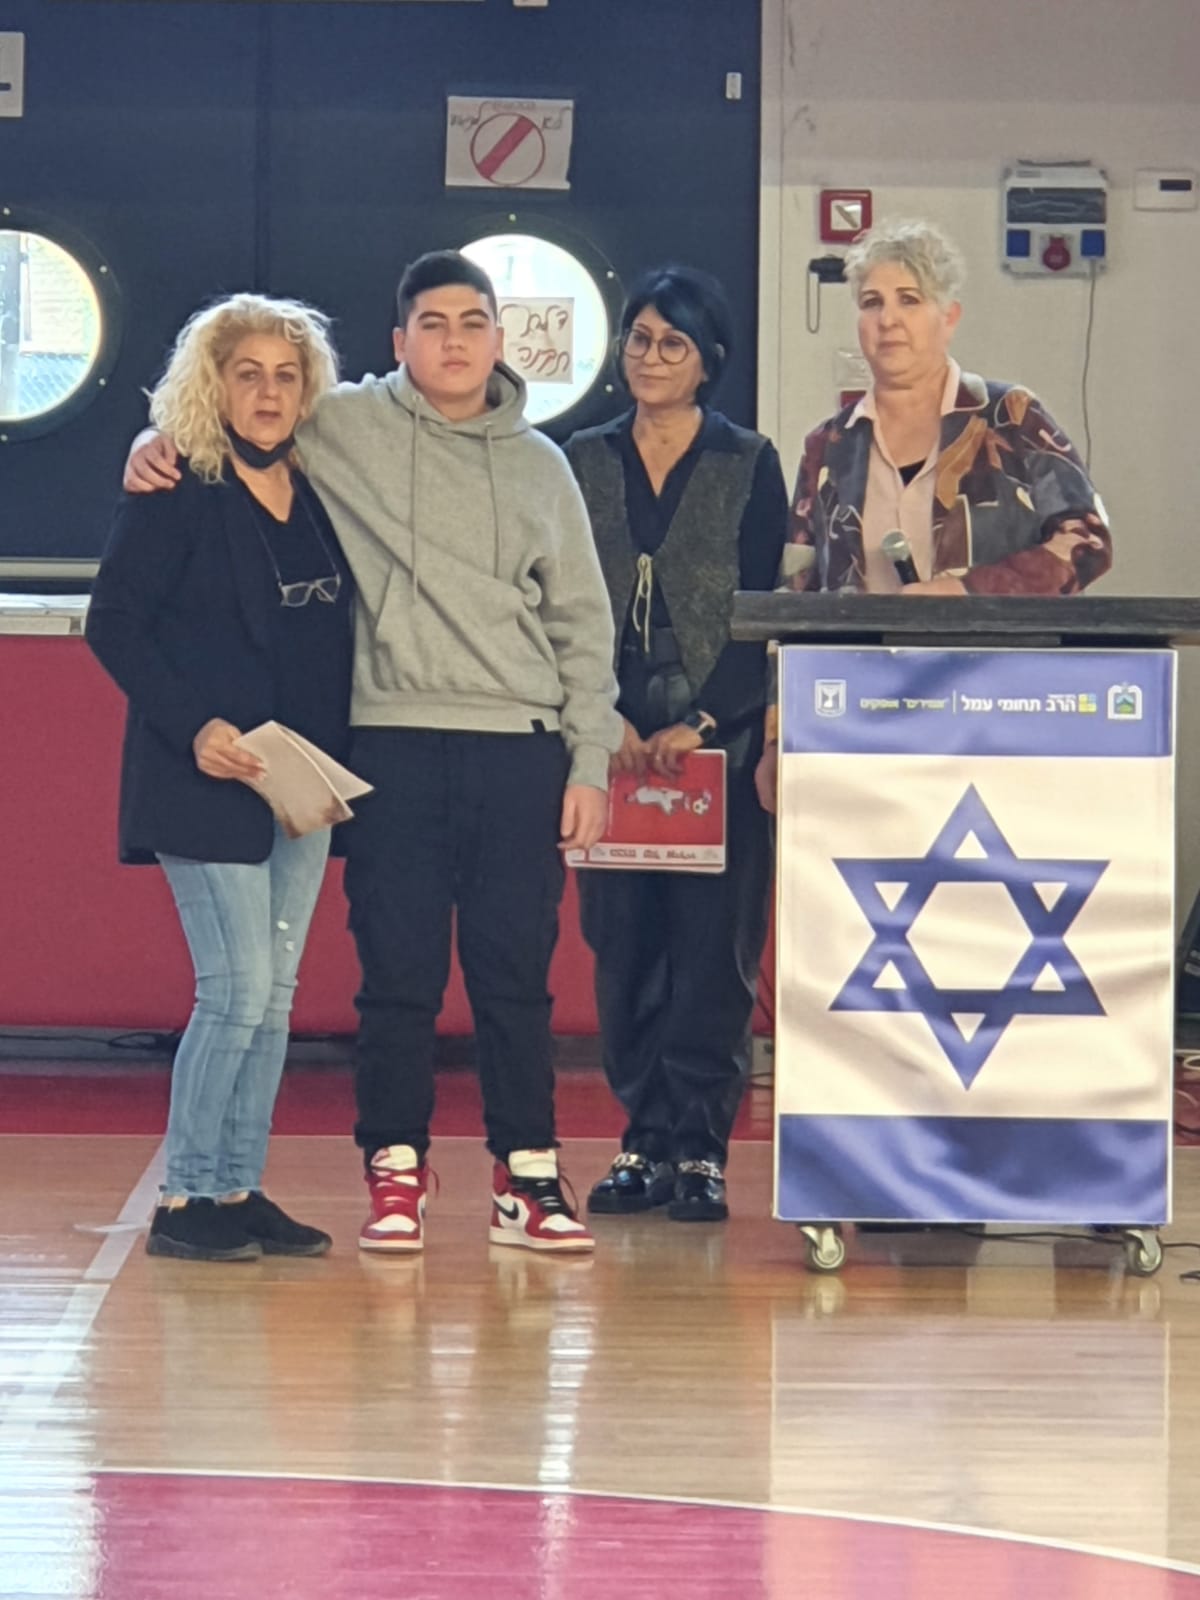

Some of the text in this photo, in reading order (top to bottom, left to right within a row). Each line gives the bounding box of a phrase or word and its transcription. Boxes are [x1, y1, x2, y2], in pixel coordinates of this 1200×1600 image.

[960, 694, 993, 711] עמל
[997, 698, 1041, 712] תחומי
[1045, 698, 1077, 712] הרב
